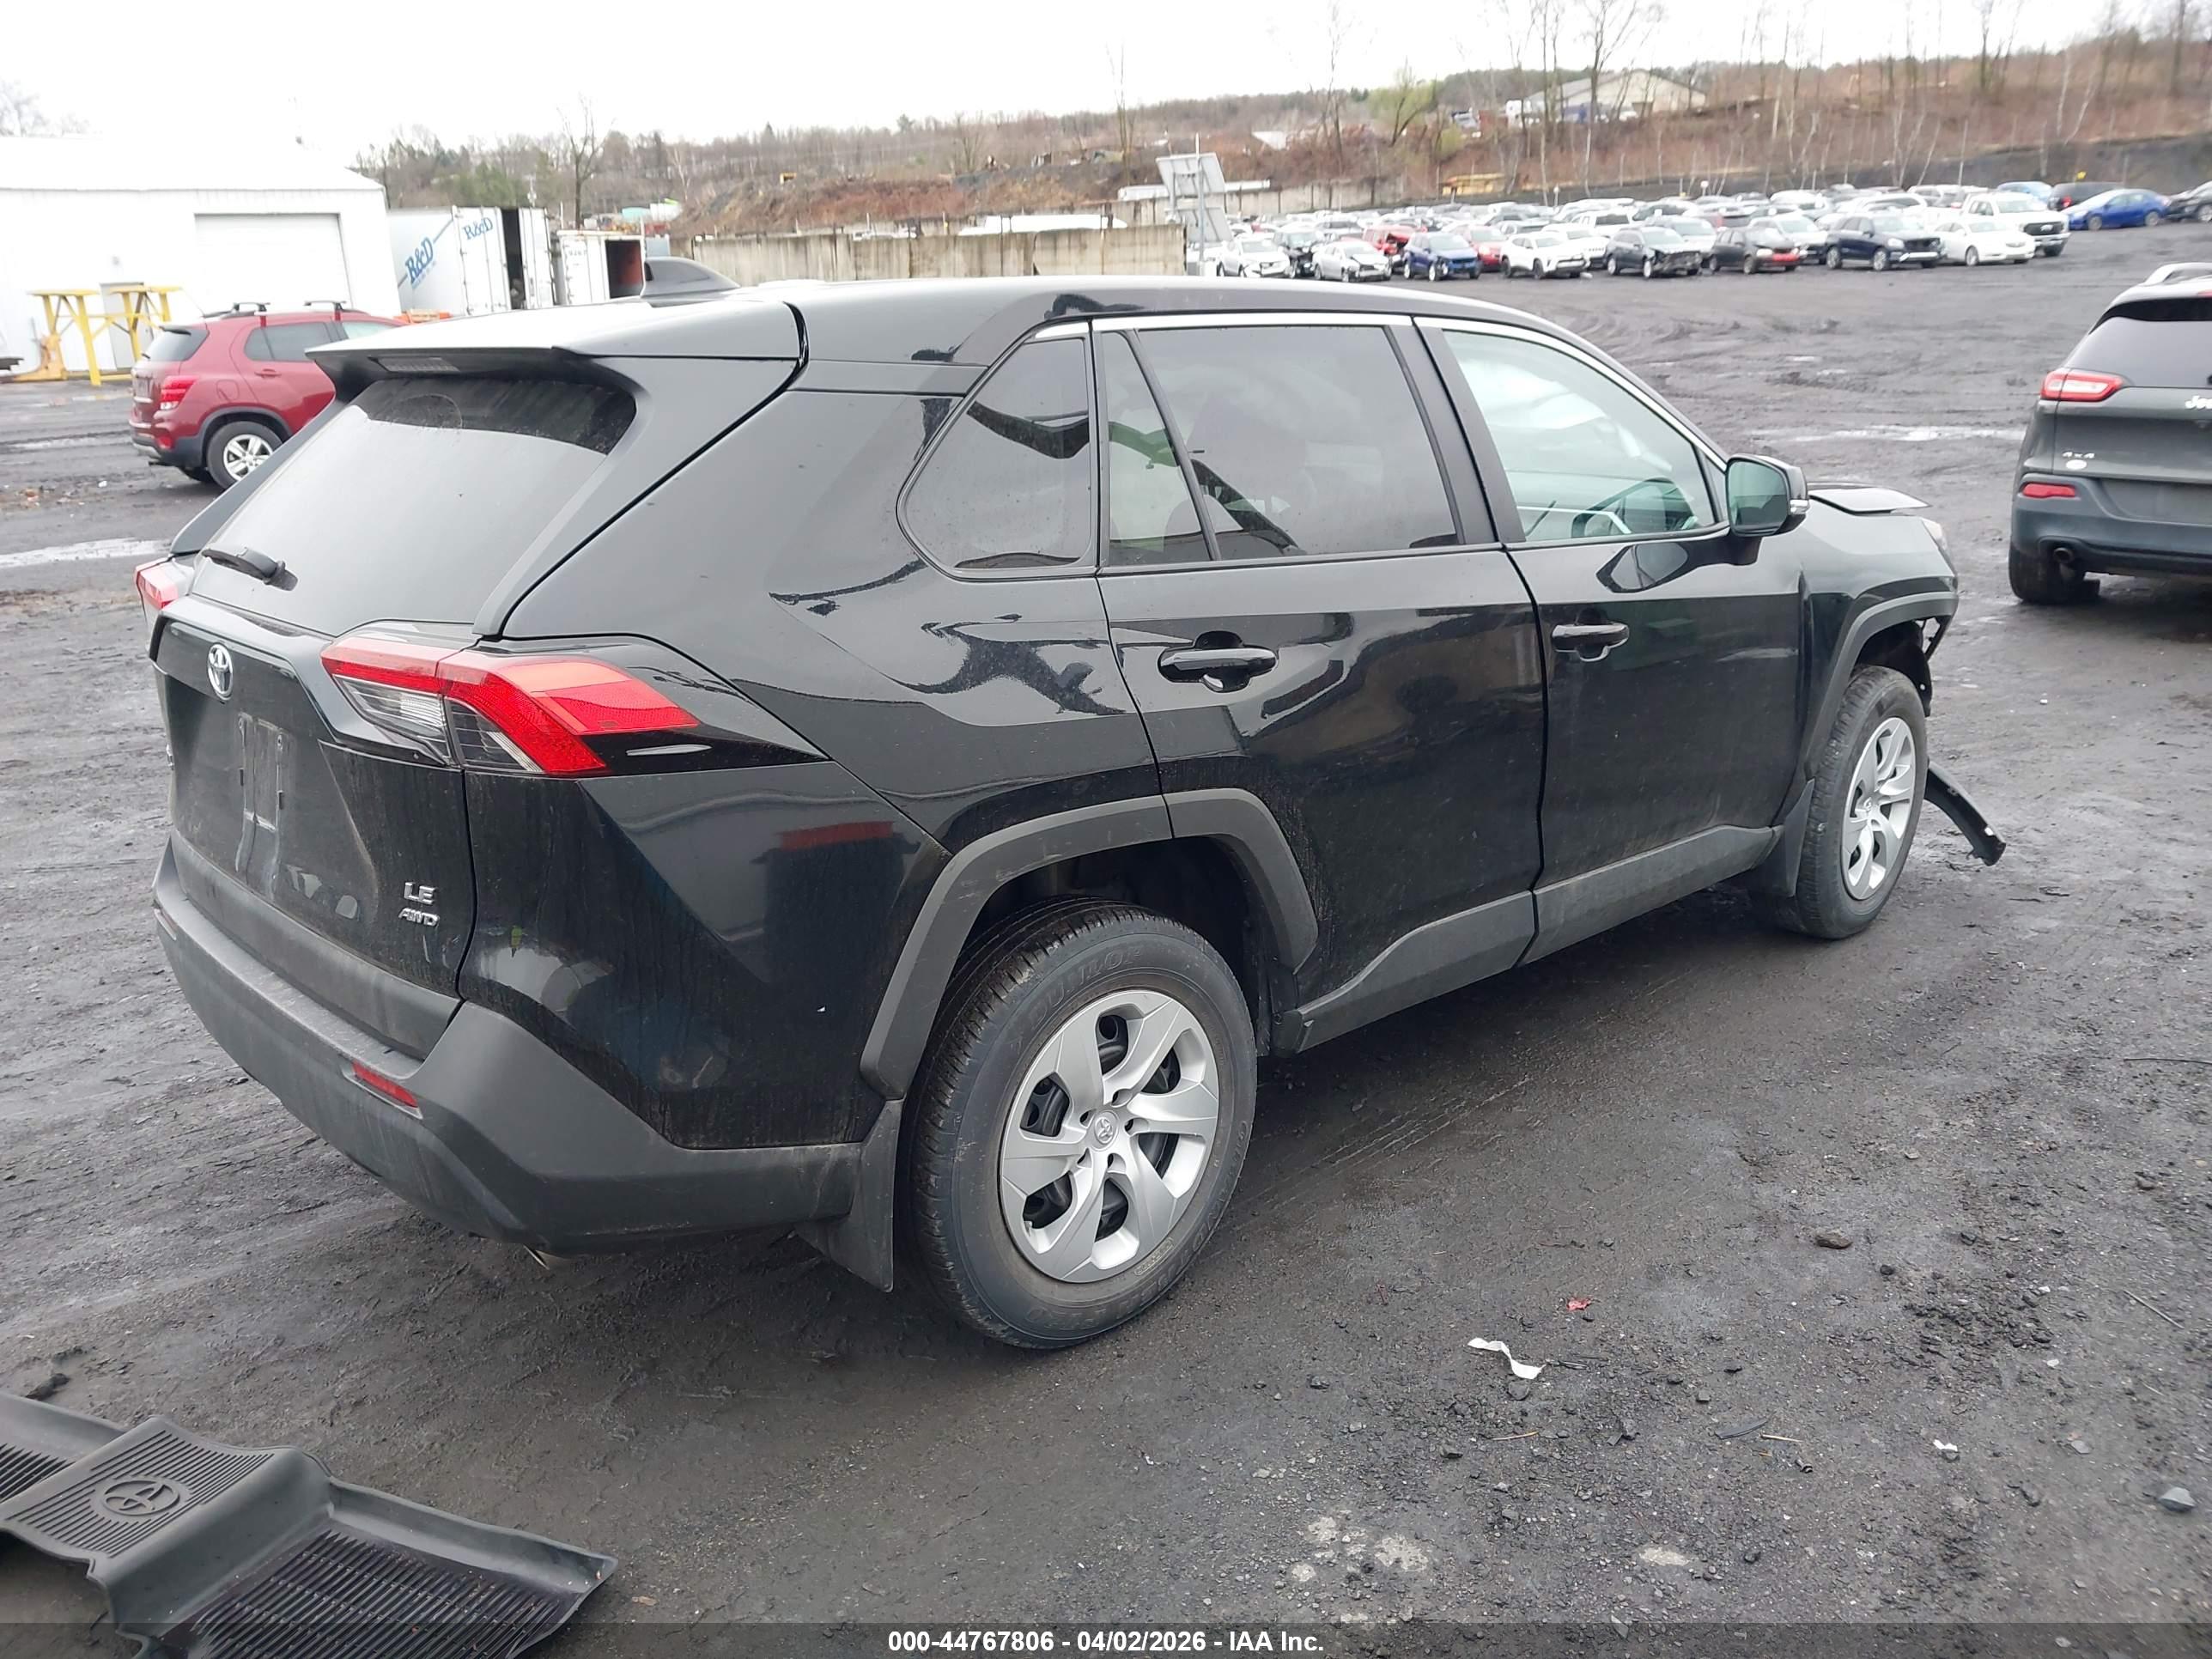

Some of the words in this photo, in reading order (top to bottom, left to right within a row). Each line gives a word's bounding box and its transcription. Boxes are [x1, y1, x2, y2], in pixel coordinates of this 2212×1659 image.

[2185, 395, 2212, 410] Jee
[404, 881, 437, 905] LE
[398, 907, 440, 927] AWD
